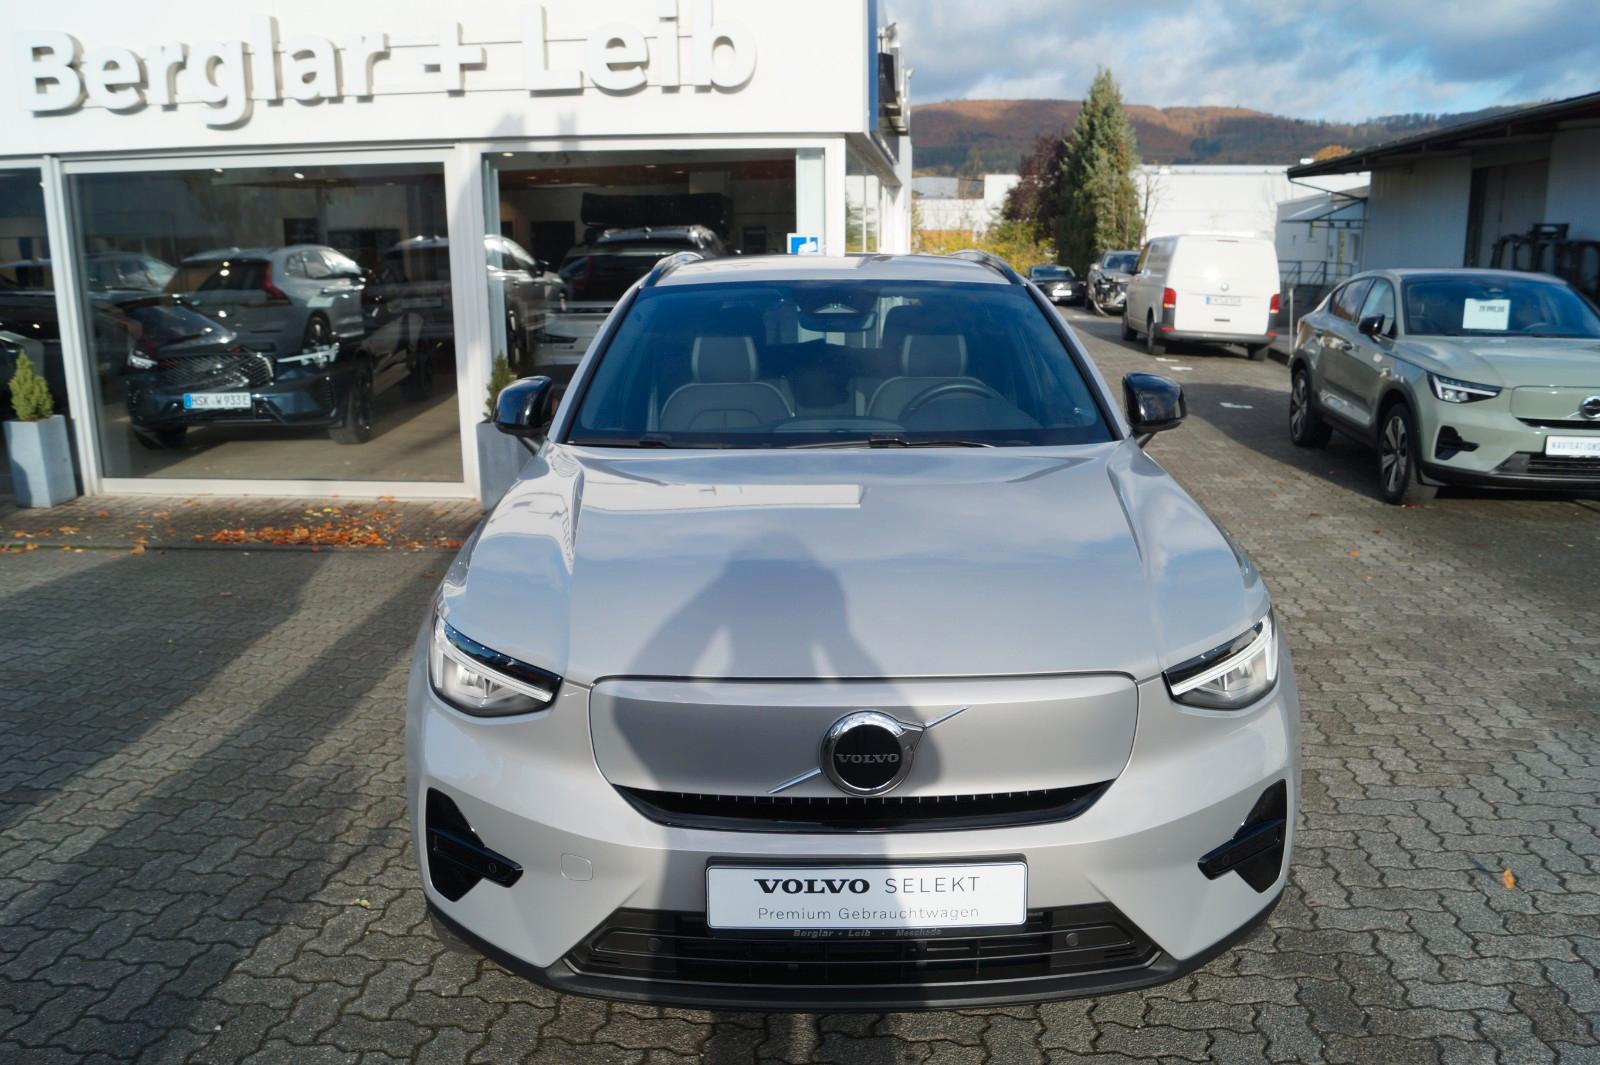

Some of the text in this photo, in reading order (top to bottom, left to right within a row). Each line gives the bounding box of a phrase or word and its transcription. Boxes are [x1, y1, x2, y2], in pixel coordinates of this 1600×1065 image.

[18, 15, 391, 131] Berglar
[522, 0, 757, 97] Leib
[835, 753, 900, 764] VOLVO
[754, 876, 981, 894] VOLVO SELEKT
[757, 907, 979, 921] Premium Gebrauchtwagen
